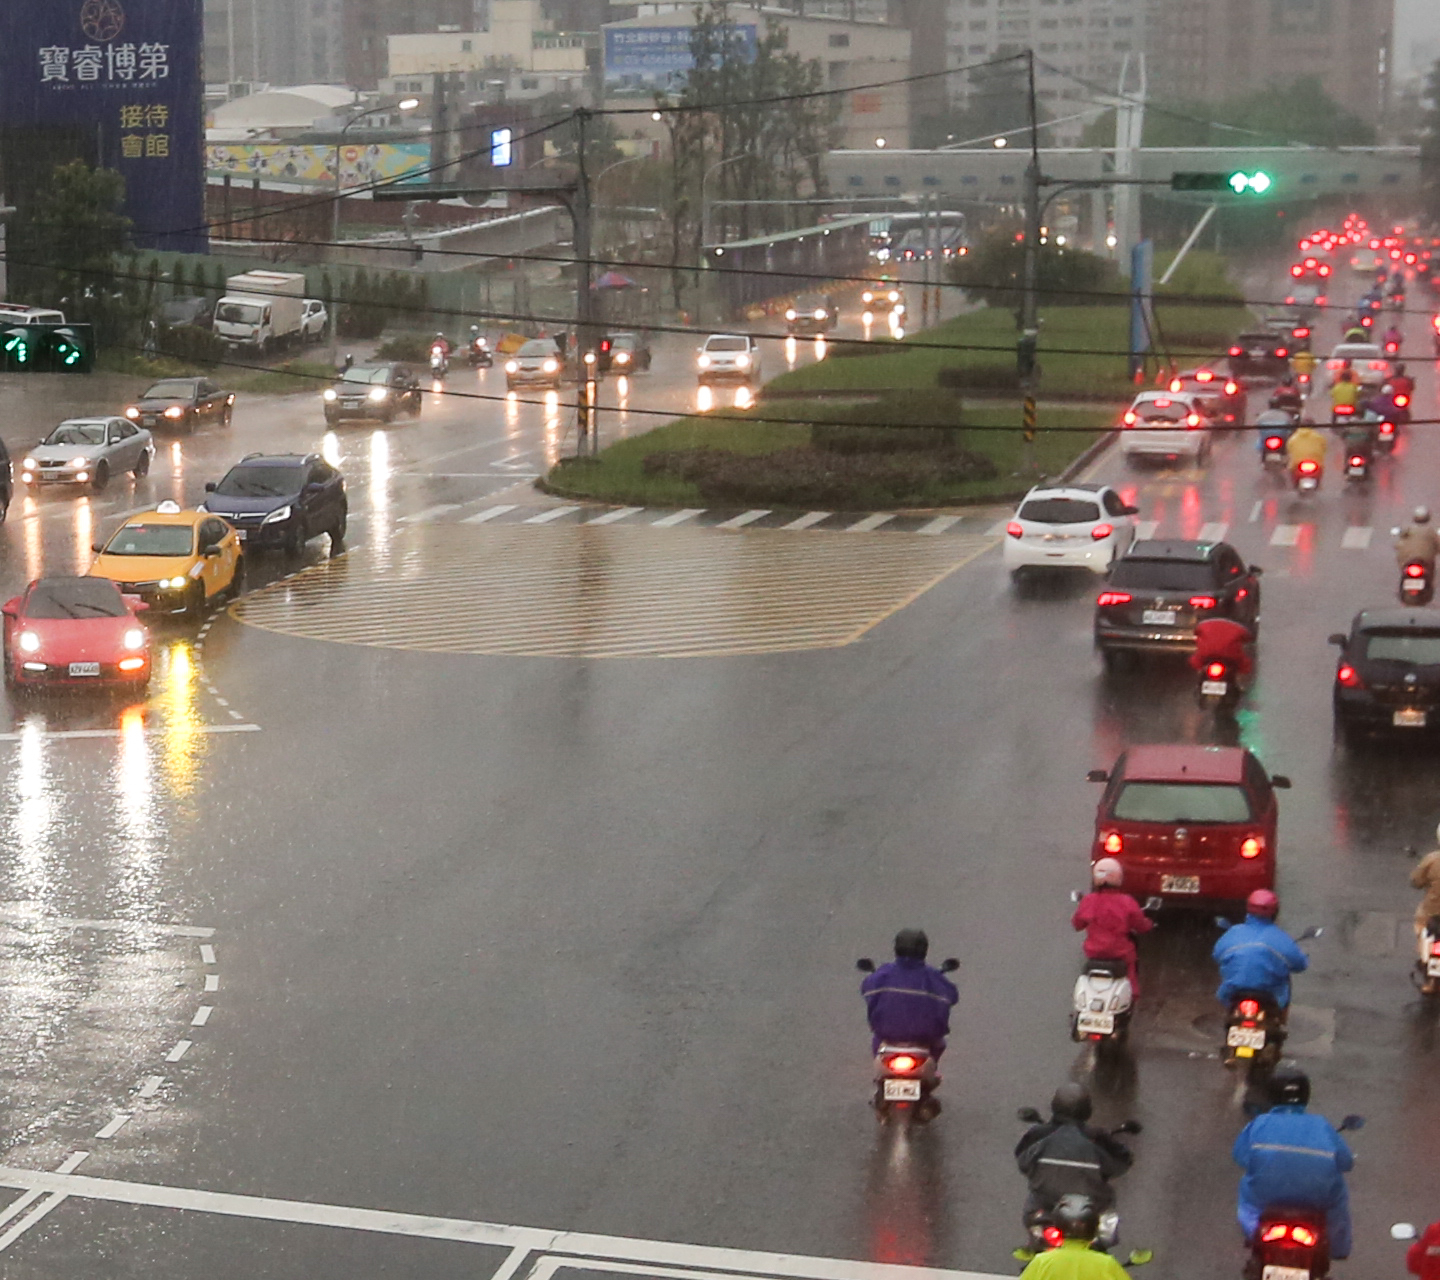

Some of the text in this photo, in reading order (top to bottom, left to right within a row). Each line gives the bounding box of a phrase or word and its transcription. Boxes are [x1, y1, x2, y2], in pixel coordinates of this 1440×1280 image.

[38, 41, 170, 83] 寶睿博第
[119, 103, 169, 130] 接待
[120, 132, 170, 158] 會館
